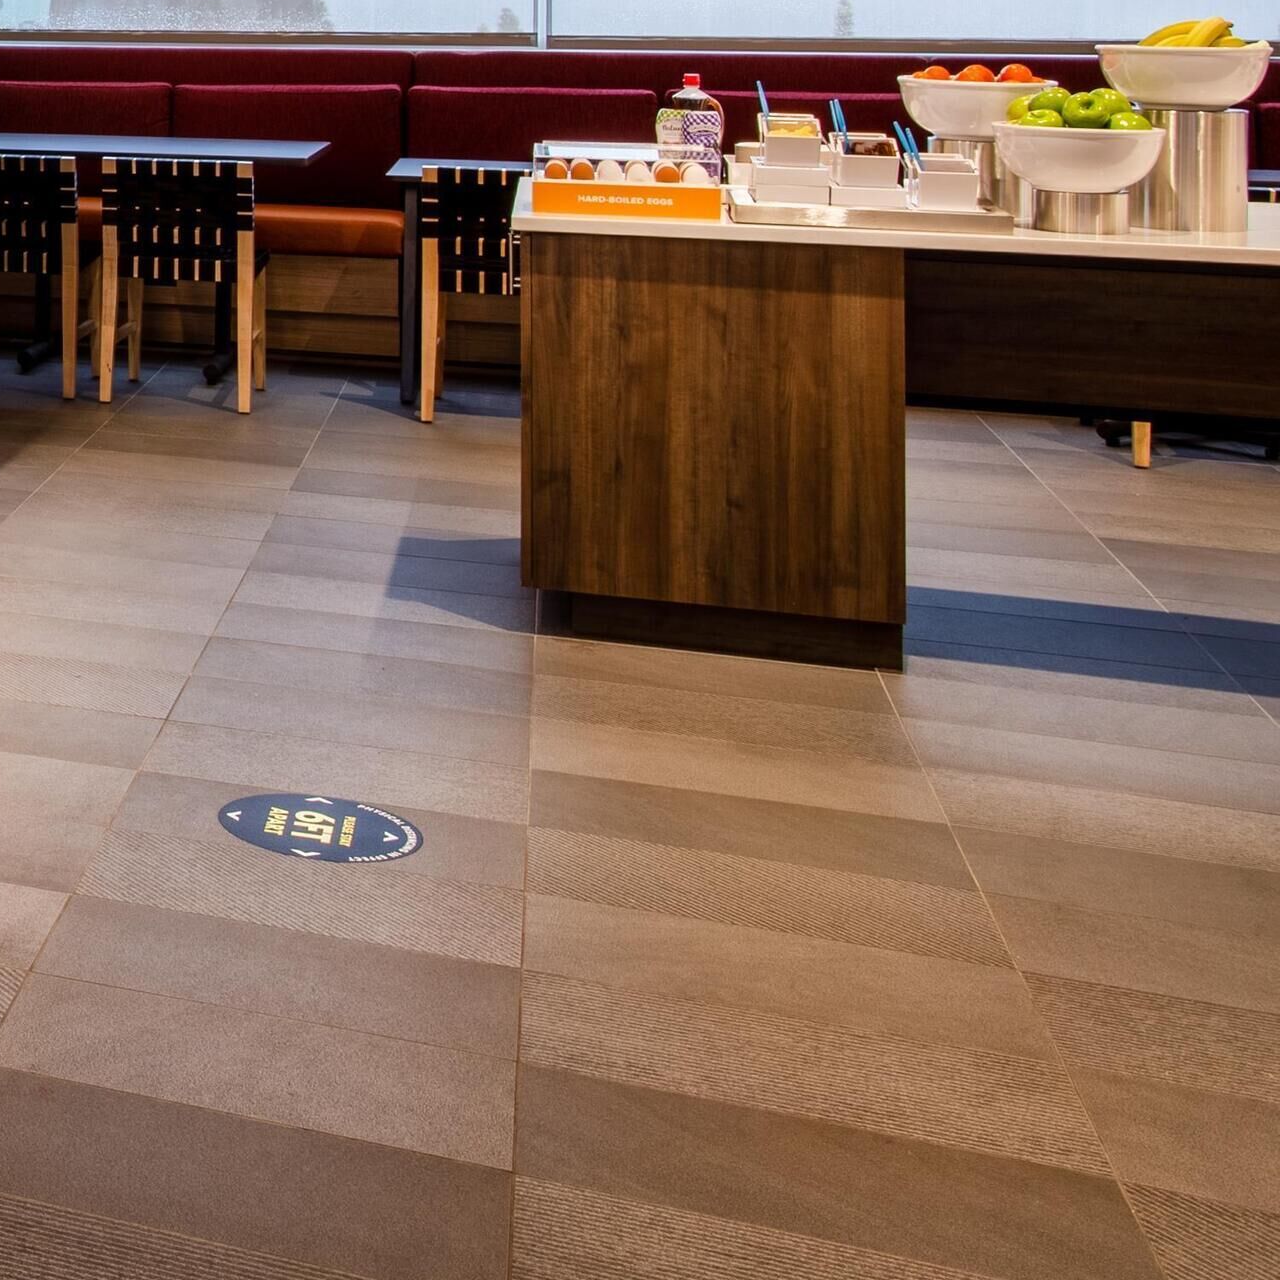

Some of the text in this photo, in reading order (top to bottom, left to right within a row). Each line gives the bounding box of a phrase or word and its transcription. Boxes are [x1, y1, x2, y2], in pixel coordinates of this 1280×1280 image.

[577, 194, 674, 206] HARD-BOILED EGGS
[263, 806, 289, 836] APART
[291, 810, 336, 844] 6FT
[356, 803, 405, 826] PHYSICAL
